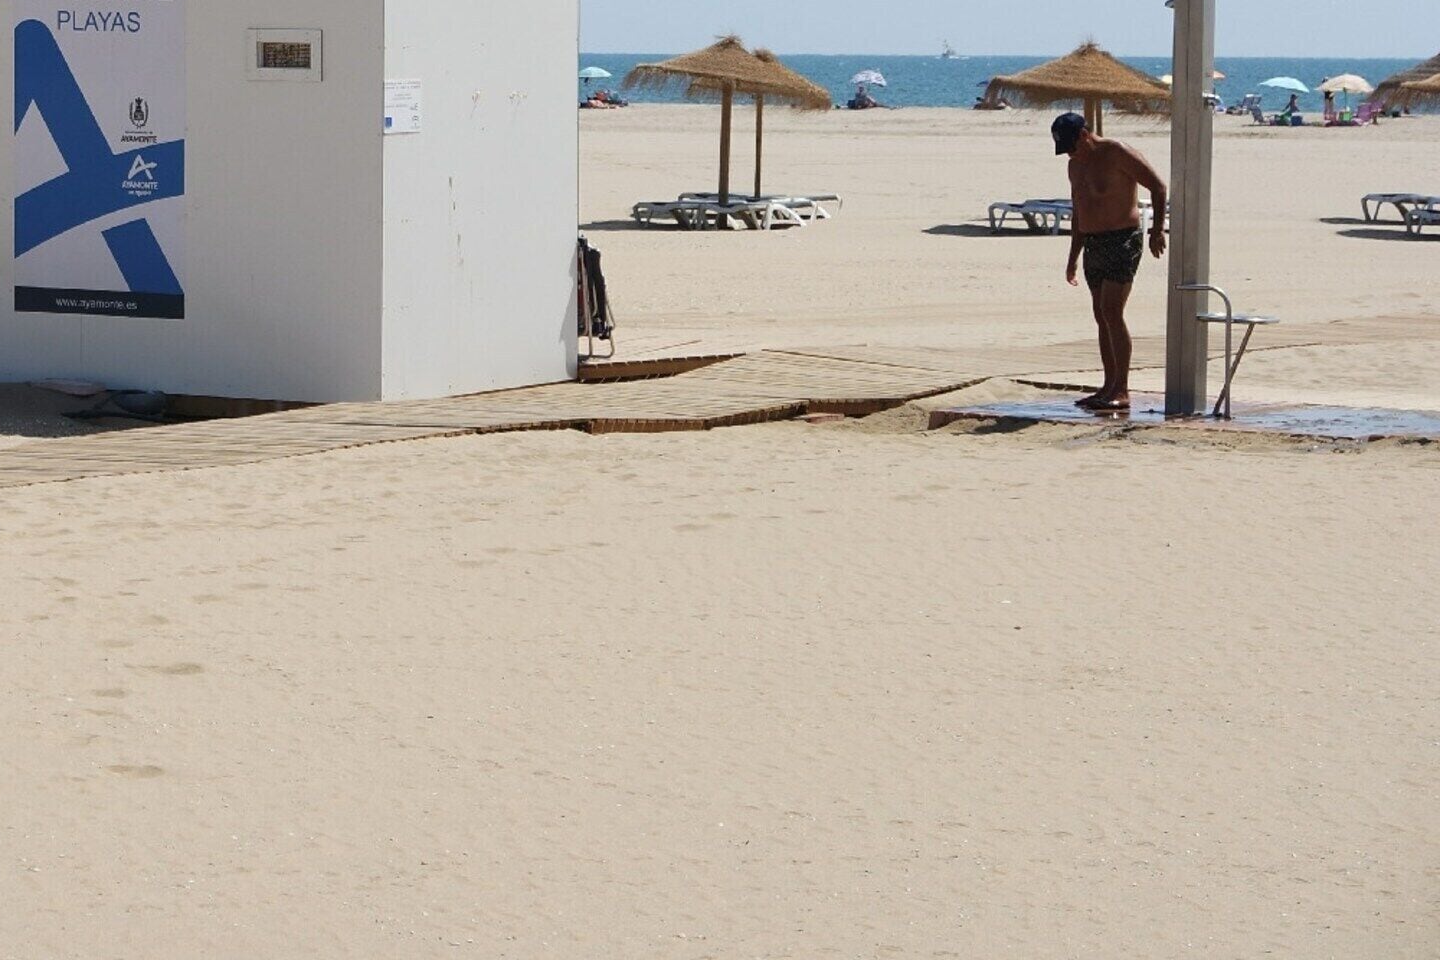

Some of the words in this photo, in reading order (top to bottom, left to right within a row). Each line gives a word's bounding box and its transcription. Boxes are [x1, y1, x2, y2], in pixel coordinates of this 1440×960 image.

[57, 10, 141, 33] PLAYAS
[122, 180, 159, 190] AYAMONTE
[55, 297, 138, 310] www.ayamonte.es
